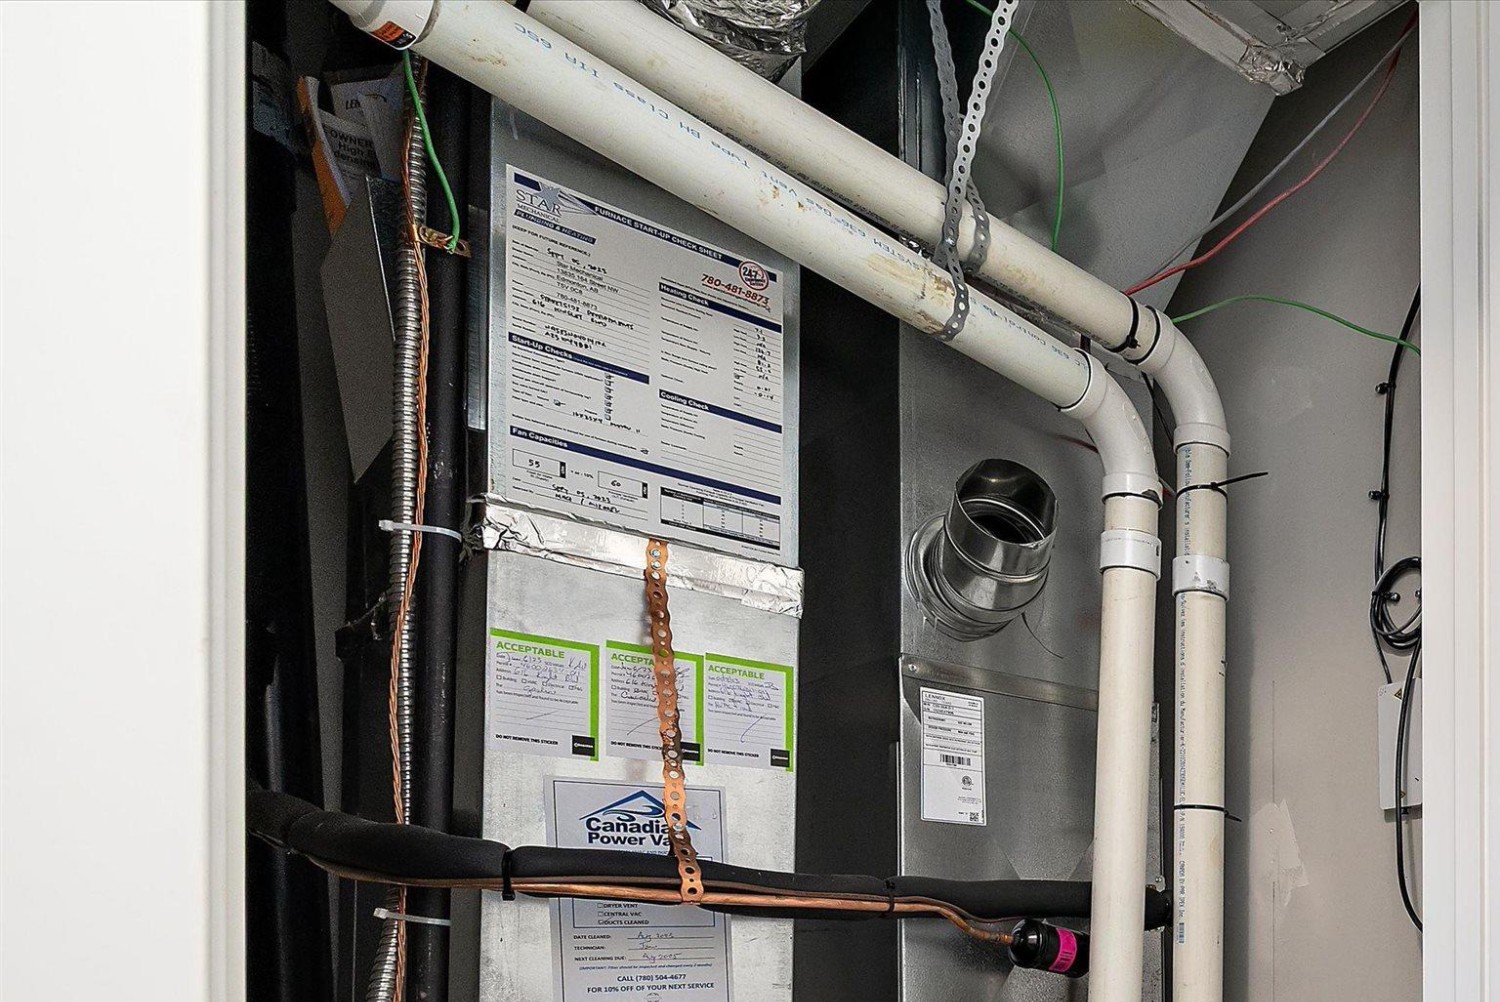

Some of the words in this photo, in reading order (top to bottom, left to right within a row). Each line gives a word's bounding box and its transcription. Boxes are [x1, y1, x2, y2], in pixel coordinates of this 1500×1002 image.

[513, 22, 552, 49] 65C
[613, 81, 669, 120] Class
[680, 121, 701, 139] BH
[711, 140, 749, 169] Type
[762, 170, 797, 197] Vent
[516, 188, 562, 216] STAR
[595, 206, 632, 227] FURNACE
[633, 221, 671, 240] START-UP
[671, 236, 698, 251] CHECK
[698, 246, 722, 260] SHEET
[661, 284, 687, 300] Heating
[688, 293, 709, 306] Check
[701, 273, 770, 307] 780-481-8873
[512, 335, 543, 350] Start-Up
[545, 346, 573, 359] Checks
[661, 391, 687, 405] Cooling
[688, 399, 709, 411] Check
[512, 428, 528, 436] Fan
[529, 431, 568, 448] Capacities
[528, 459, 540, 468] 55
[496, 641, 565, 658] ACCEPTABLE
[611, 653, 655, 665] ACCEPTA
[708, 665, 764, 679] ACCEPTABLE
[586, 817, 669, 833] Canadia
[588, 832, 646, 845] Power
[650, 835, 670, 847] Va
[636, 974, 654, 982] (780)
